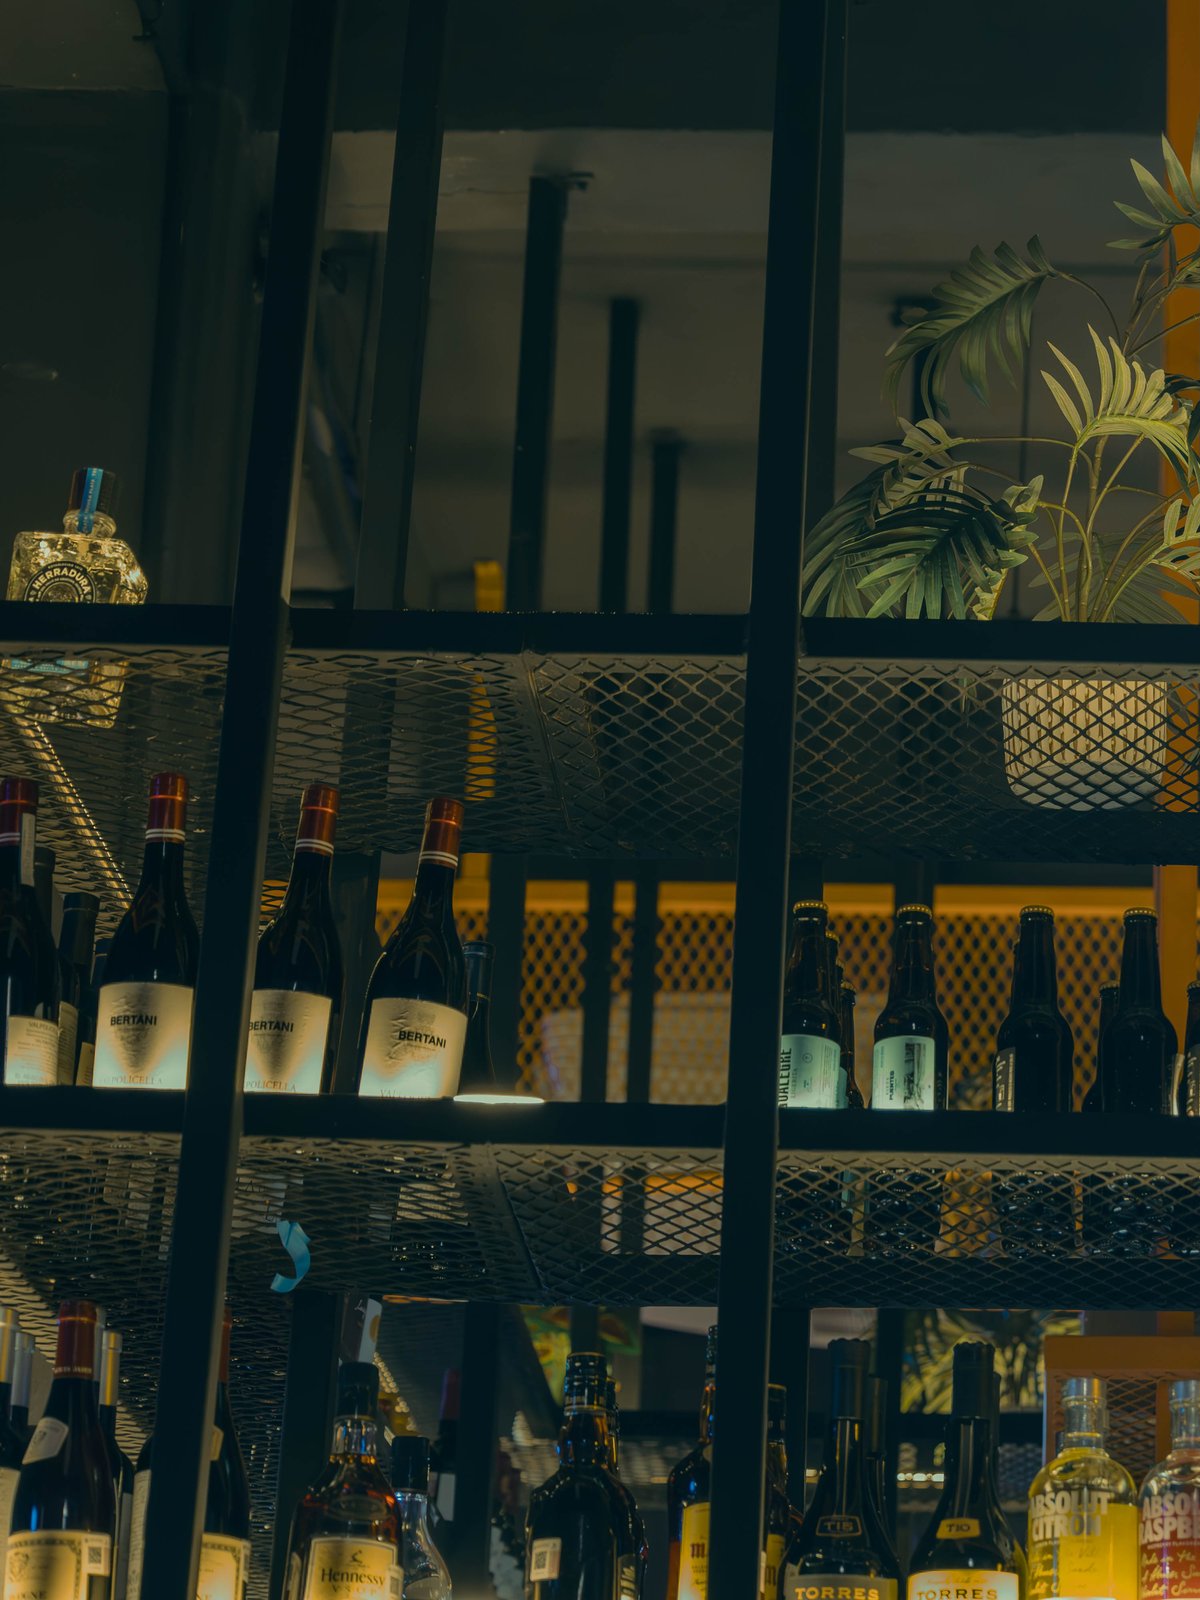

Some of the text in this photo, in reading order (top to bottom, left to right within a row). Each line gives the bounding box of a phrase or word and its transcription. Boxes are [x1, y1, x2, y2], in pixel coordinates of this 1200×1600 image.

[33, 567, 91, 593] HERRADURA
[110, 1015, 157, 1026] BERTANI
[247, 1020, 294, 1033] BERTANI
[398, 1030, 447, 1049] BERTANI
[1030, 1490, 1111, 1519] ABSOLUT
[1031, 1514, 1102, 1542] CITRON
[321, 1568, 386, 1586] Hennessy
[794, 1586, 880, 1600] TORRES
[917, 1588, 998, 1600] TORRES
